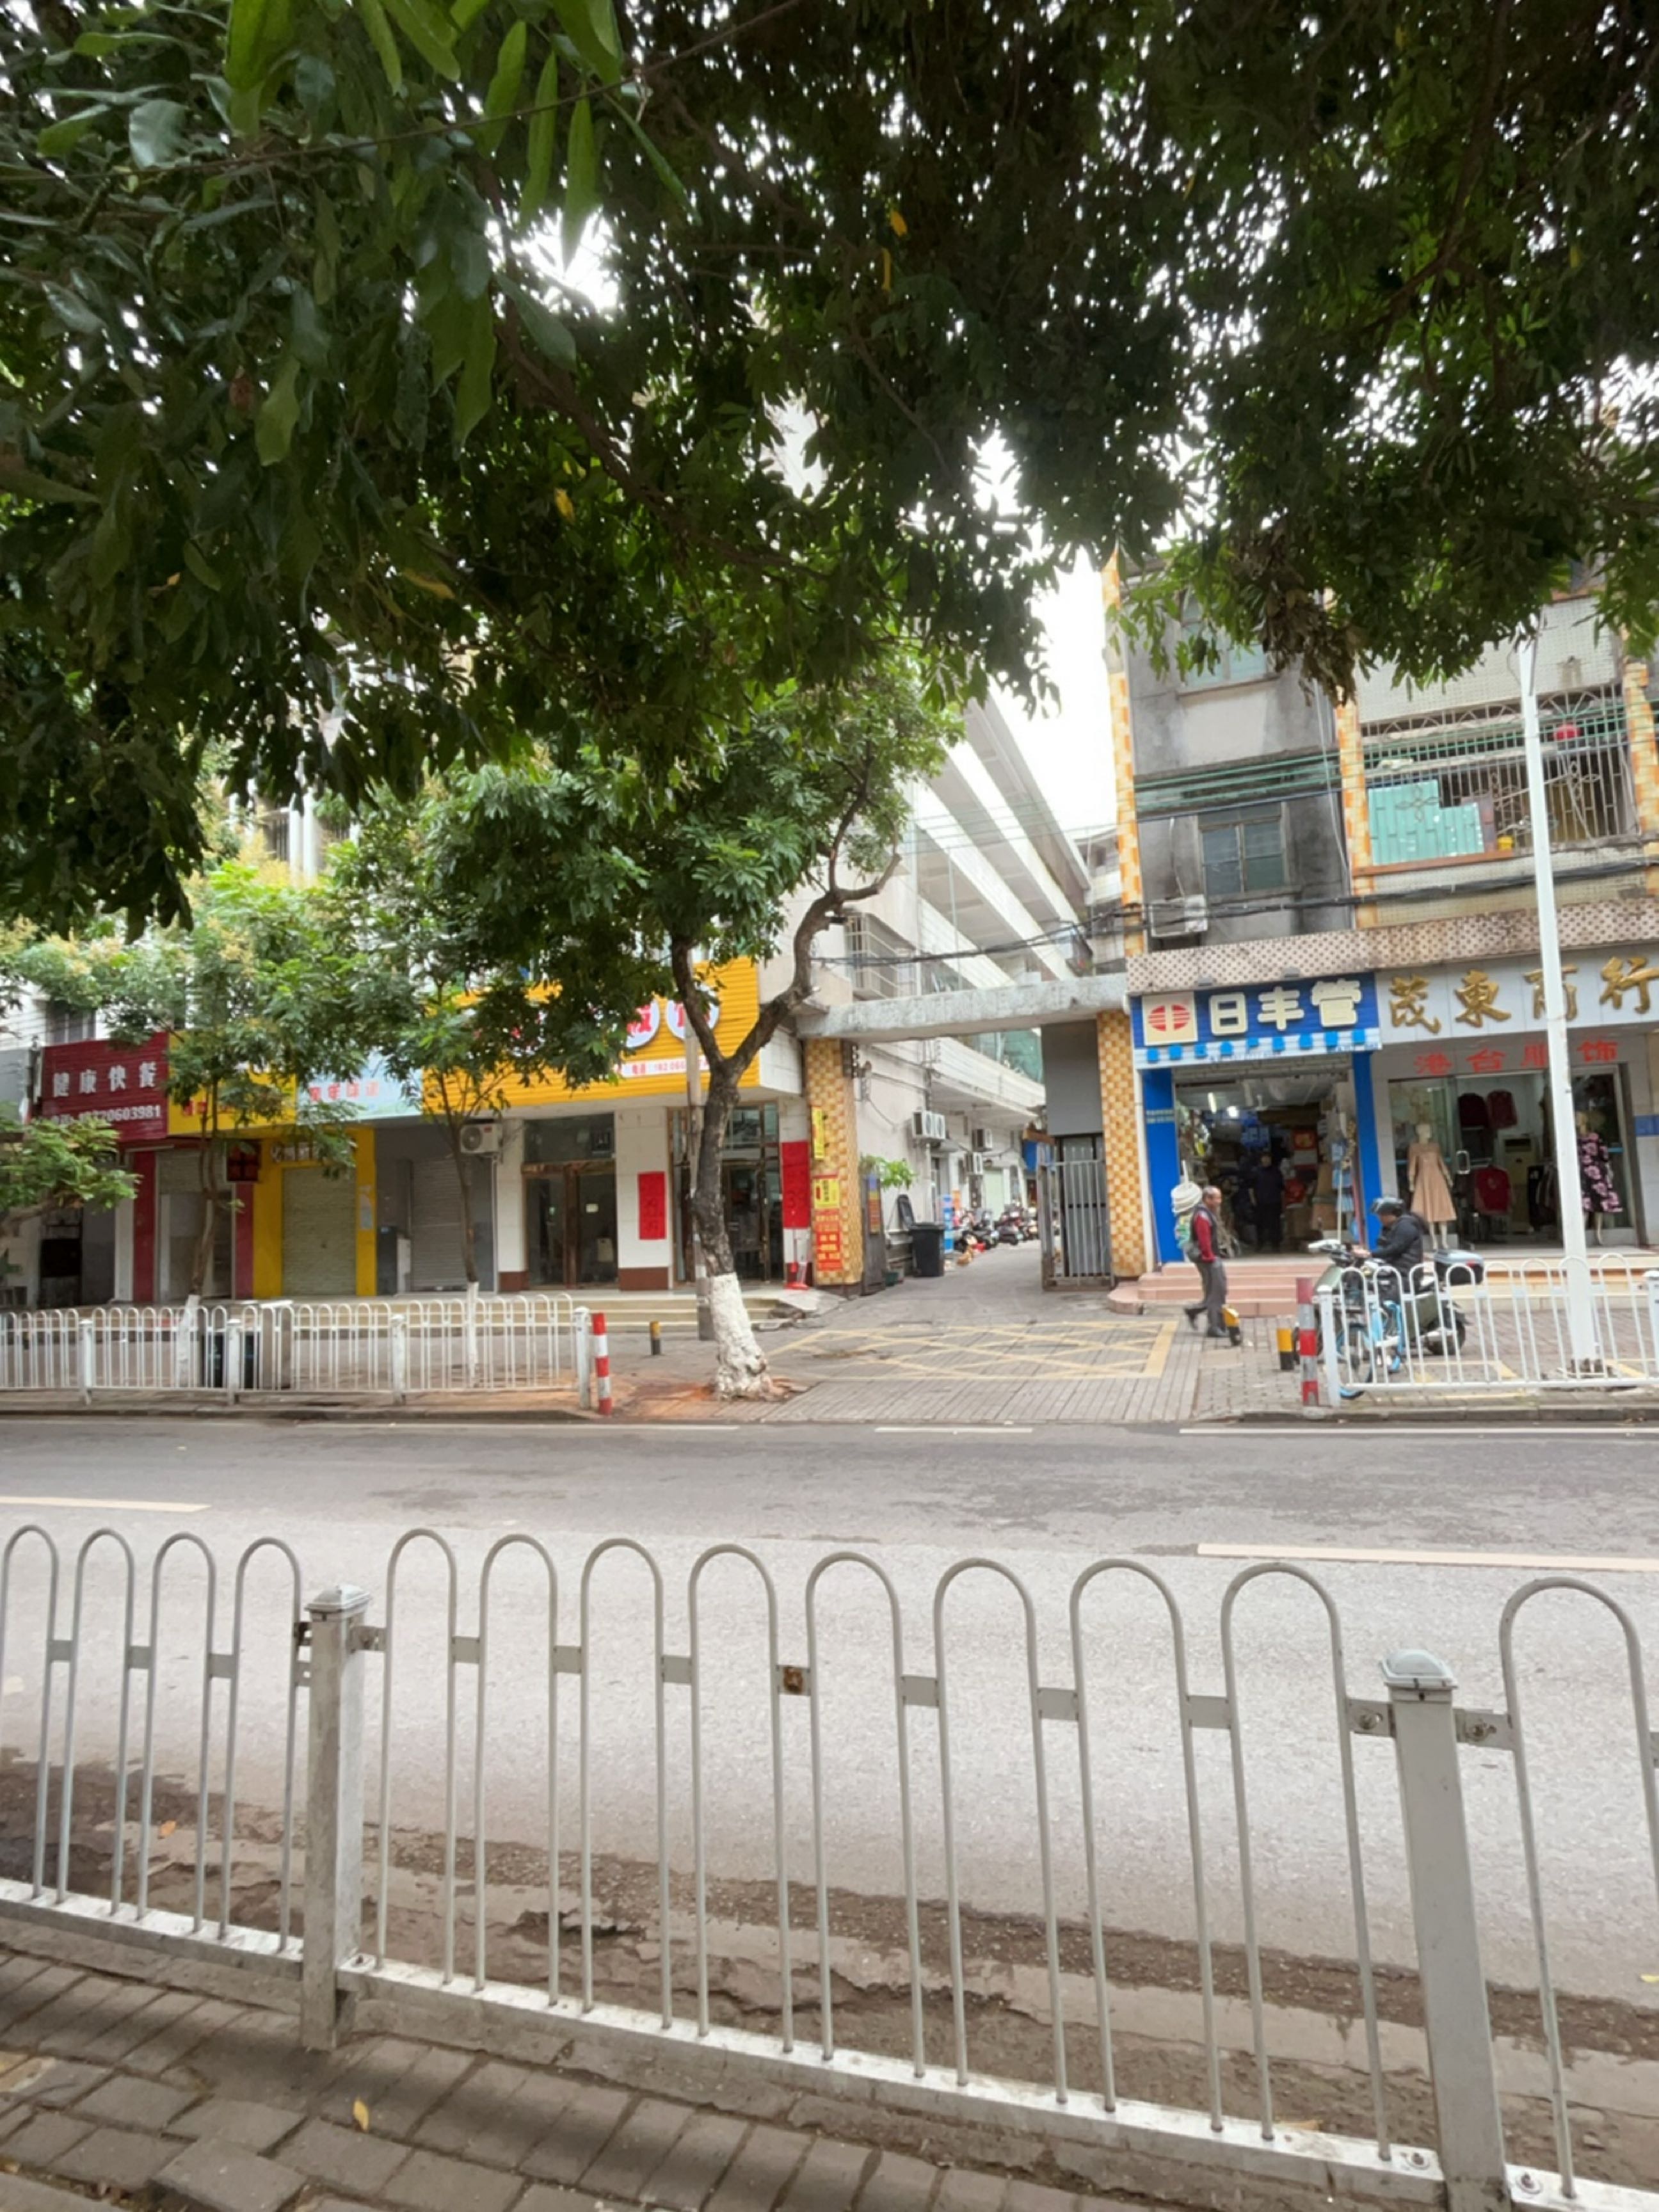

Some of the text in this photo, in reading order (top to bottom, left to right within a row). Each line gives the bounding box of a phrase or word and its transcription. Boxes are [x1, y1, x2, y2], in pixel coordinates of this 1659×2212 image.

[1208, 979, 1362, 1036] 日丰管
[1414, 1039, 1619, 1076] 港台服饰
[53, 1061, 157, 1098] 健康快餐
[78, 1104, 161, 1121] 0603981
